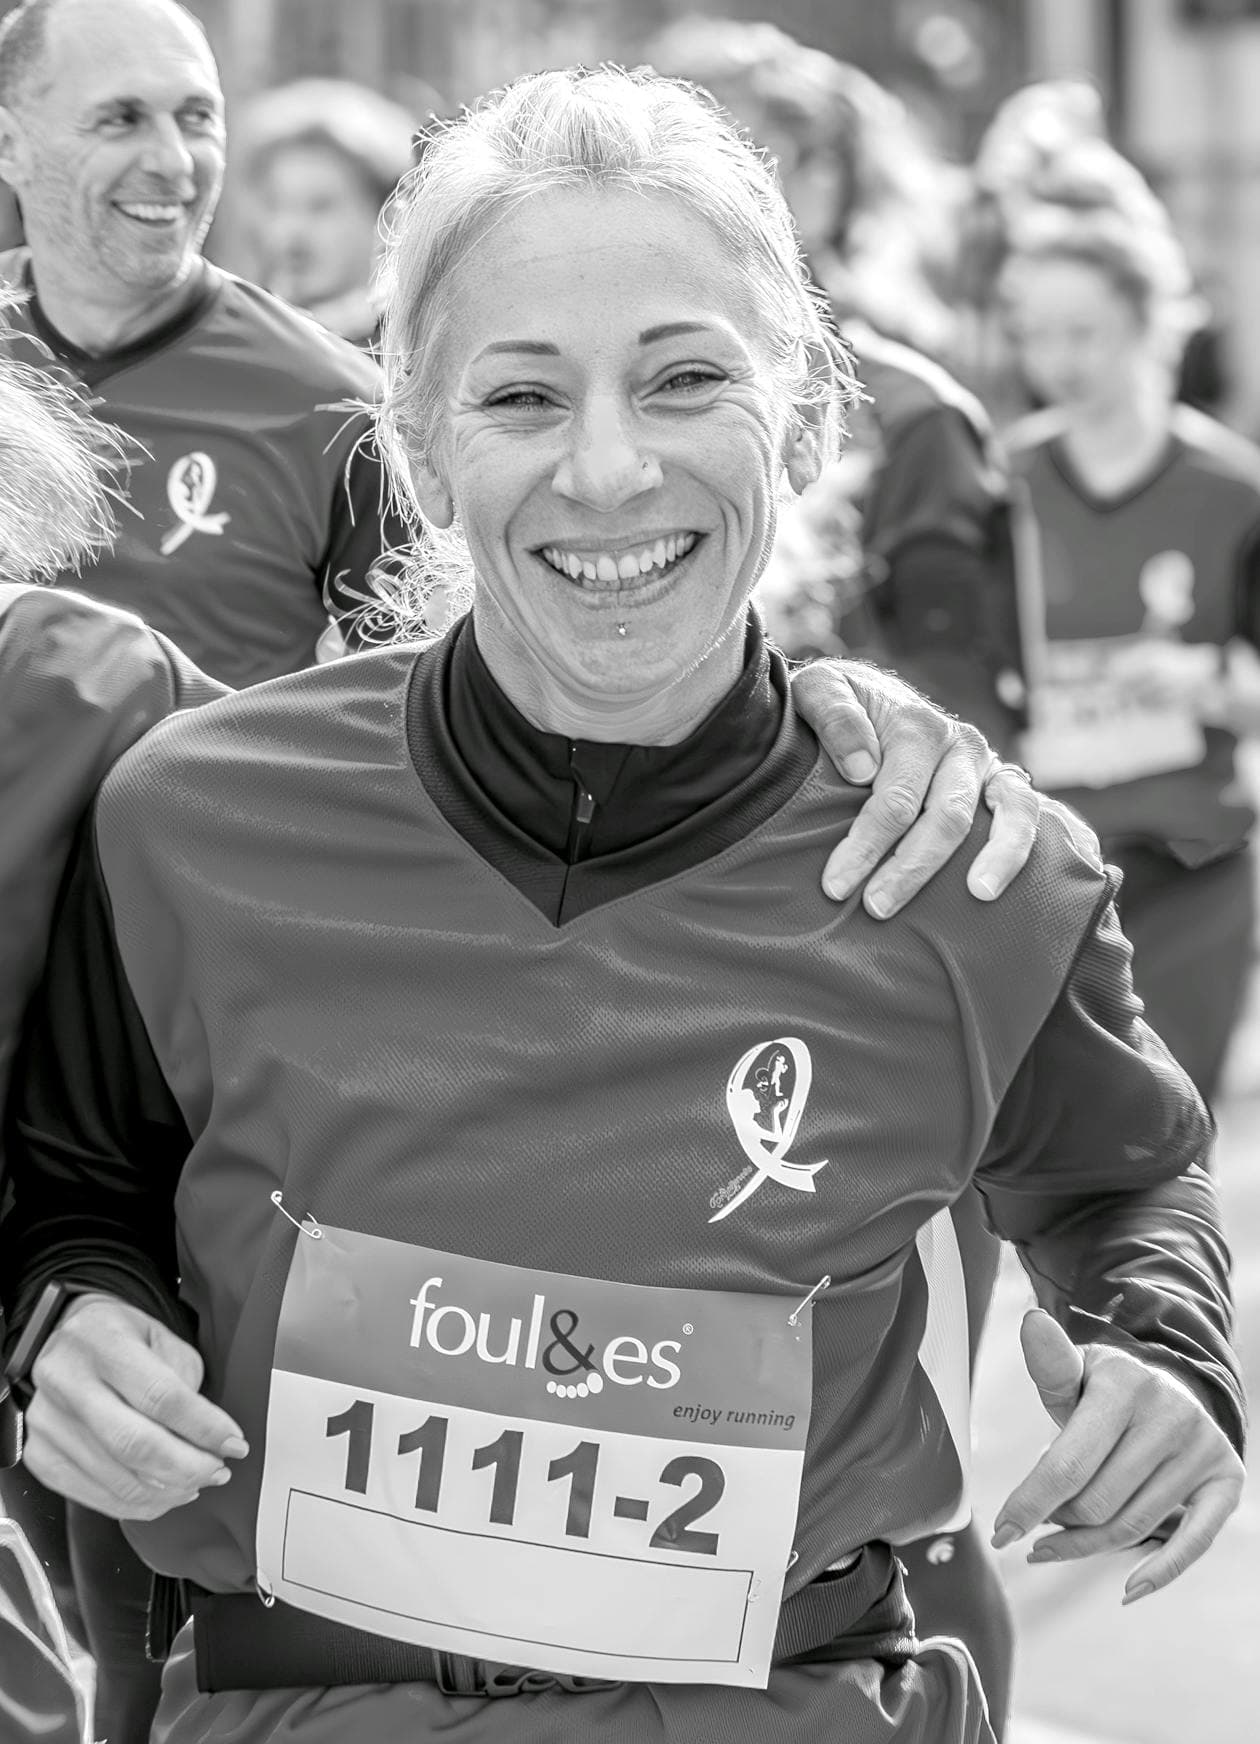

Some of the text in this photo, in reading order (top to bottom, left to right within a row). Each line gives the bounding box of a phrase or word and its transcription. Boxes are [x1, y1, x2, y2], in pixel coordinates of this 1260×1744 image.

[673, 1404, 796, 1431] enjoy running
[325, 1399, 726, 1556] 1111-2
